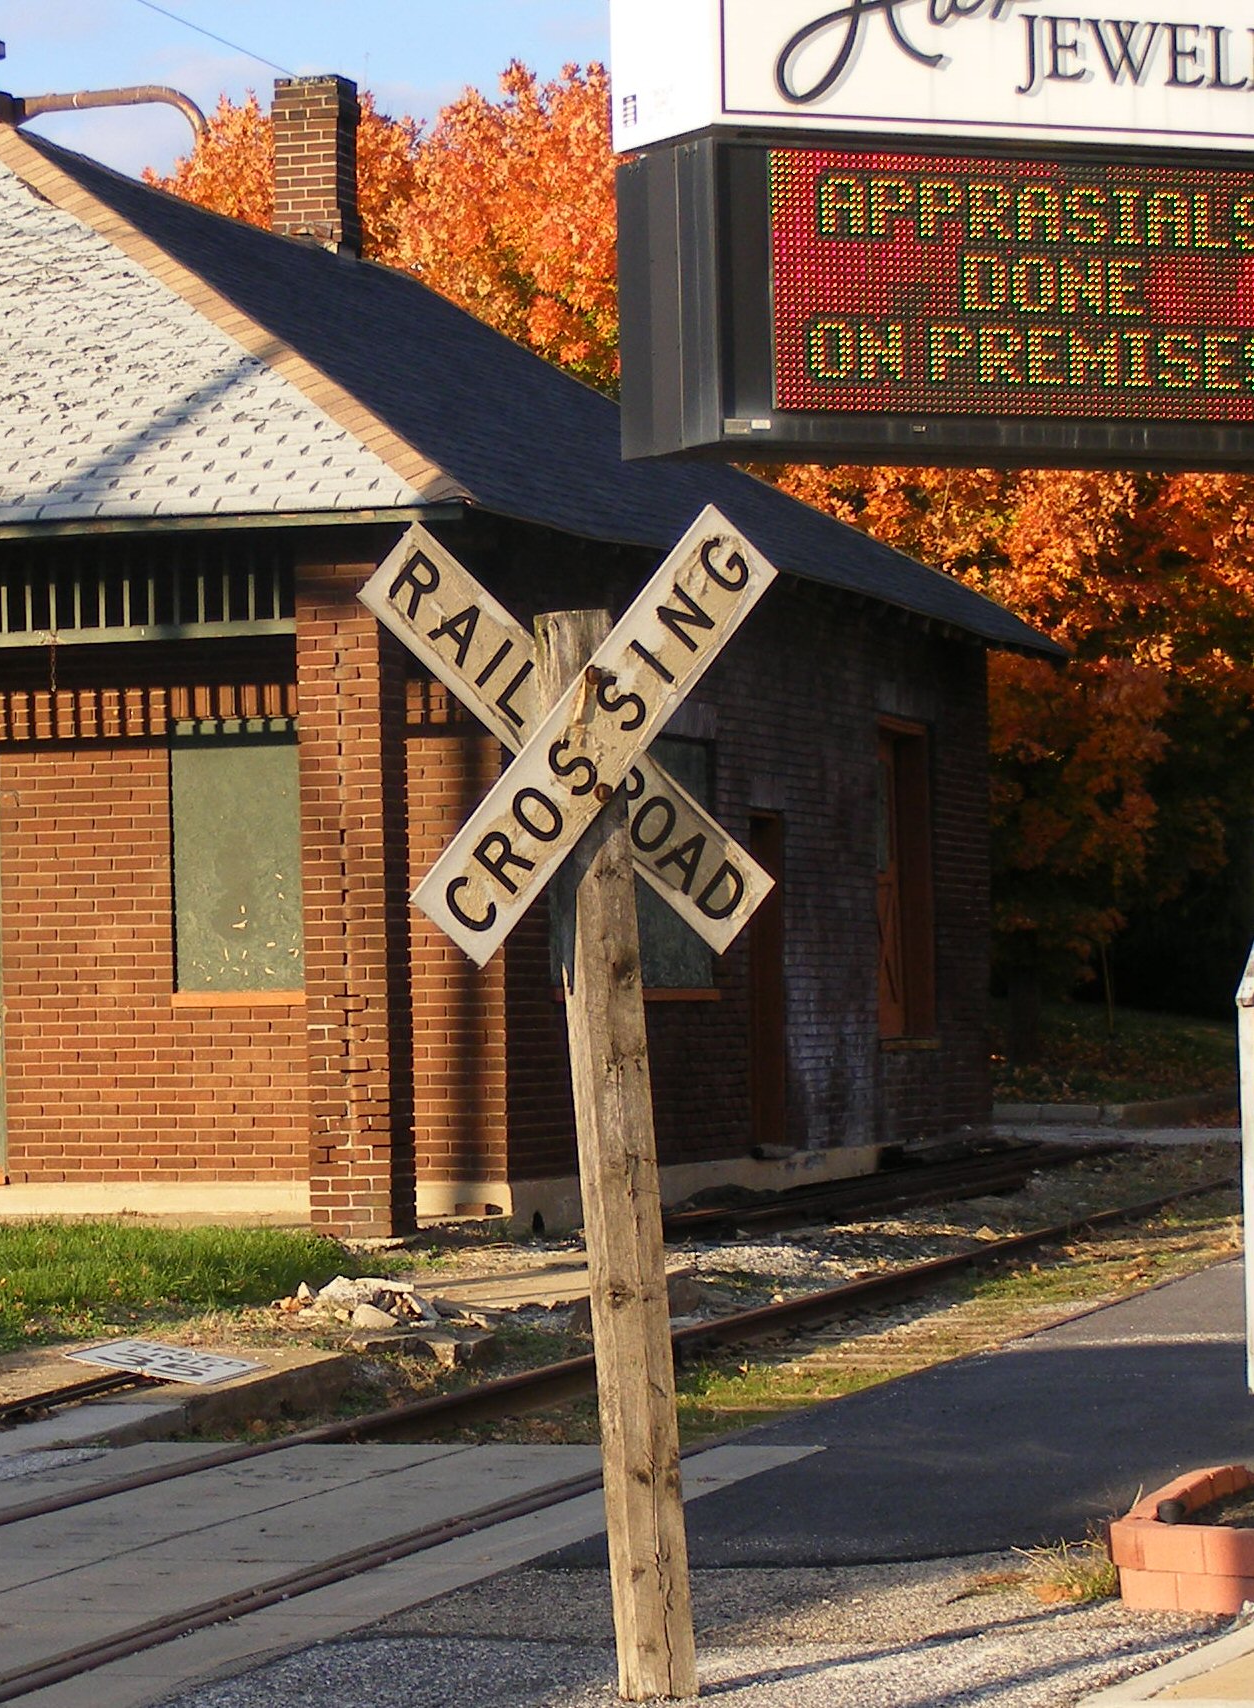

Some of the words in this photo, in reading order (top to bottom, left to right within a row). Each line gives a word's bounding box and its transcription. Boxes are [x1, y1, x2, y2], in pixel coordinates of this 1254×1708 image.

[1014, 14, 1254, 94] JEWEL
[962, 254, 1144, 316] DONE
[808, 320, 905, 382] ON
[929, 325, 1254, 391] PREMISE
[388, 548, 535, 728] RAIL
[445, 536, 750, 933] CROSSING
